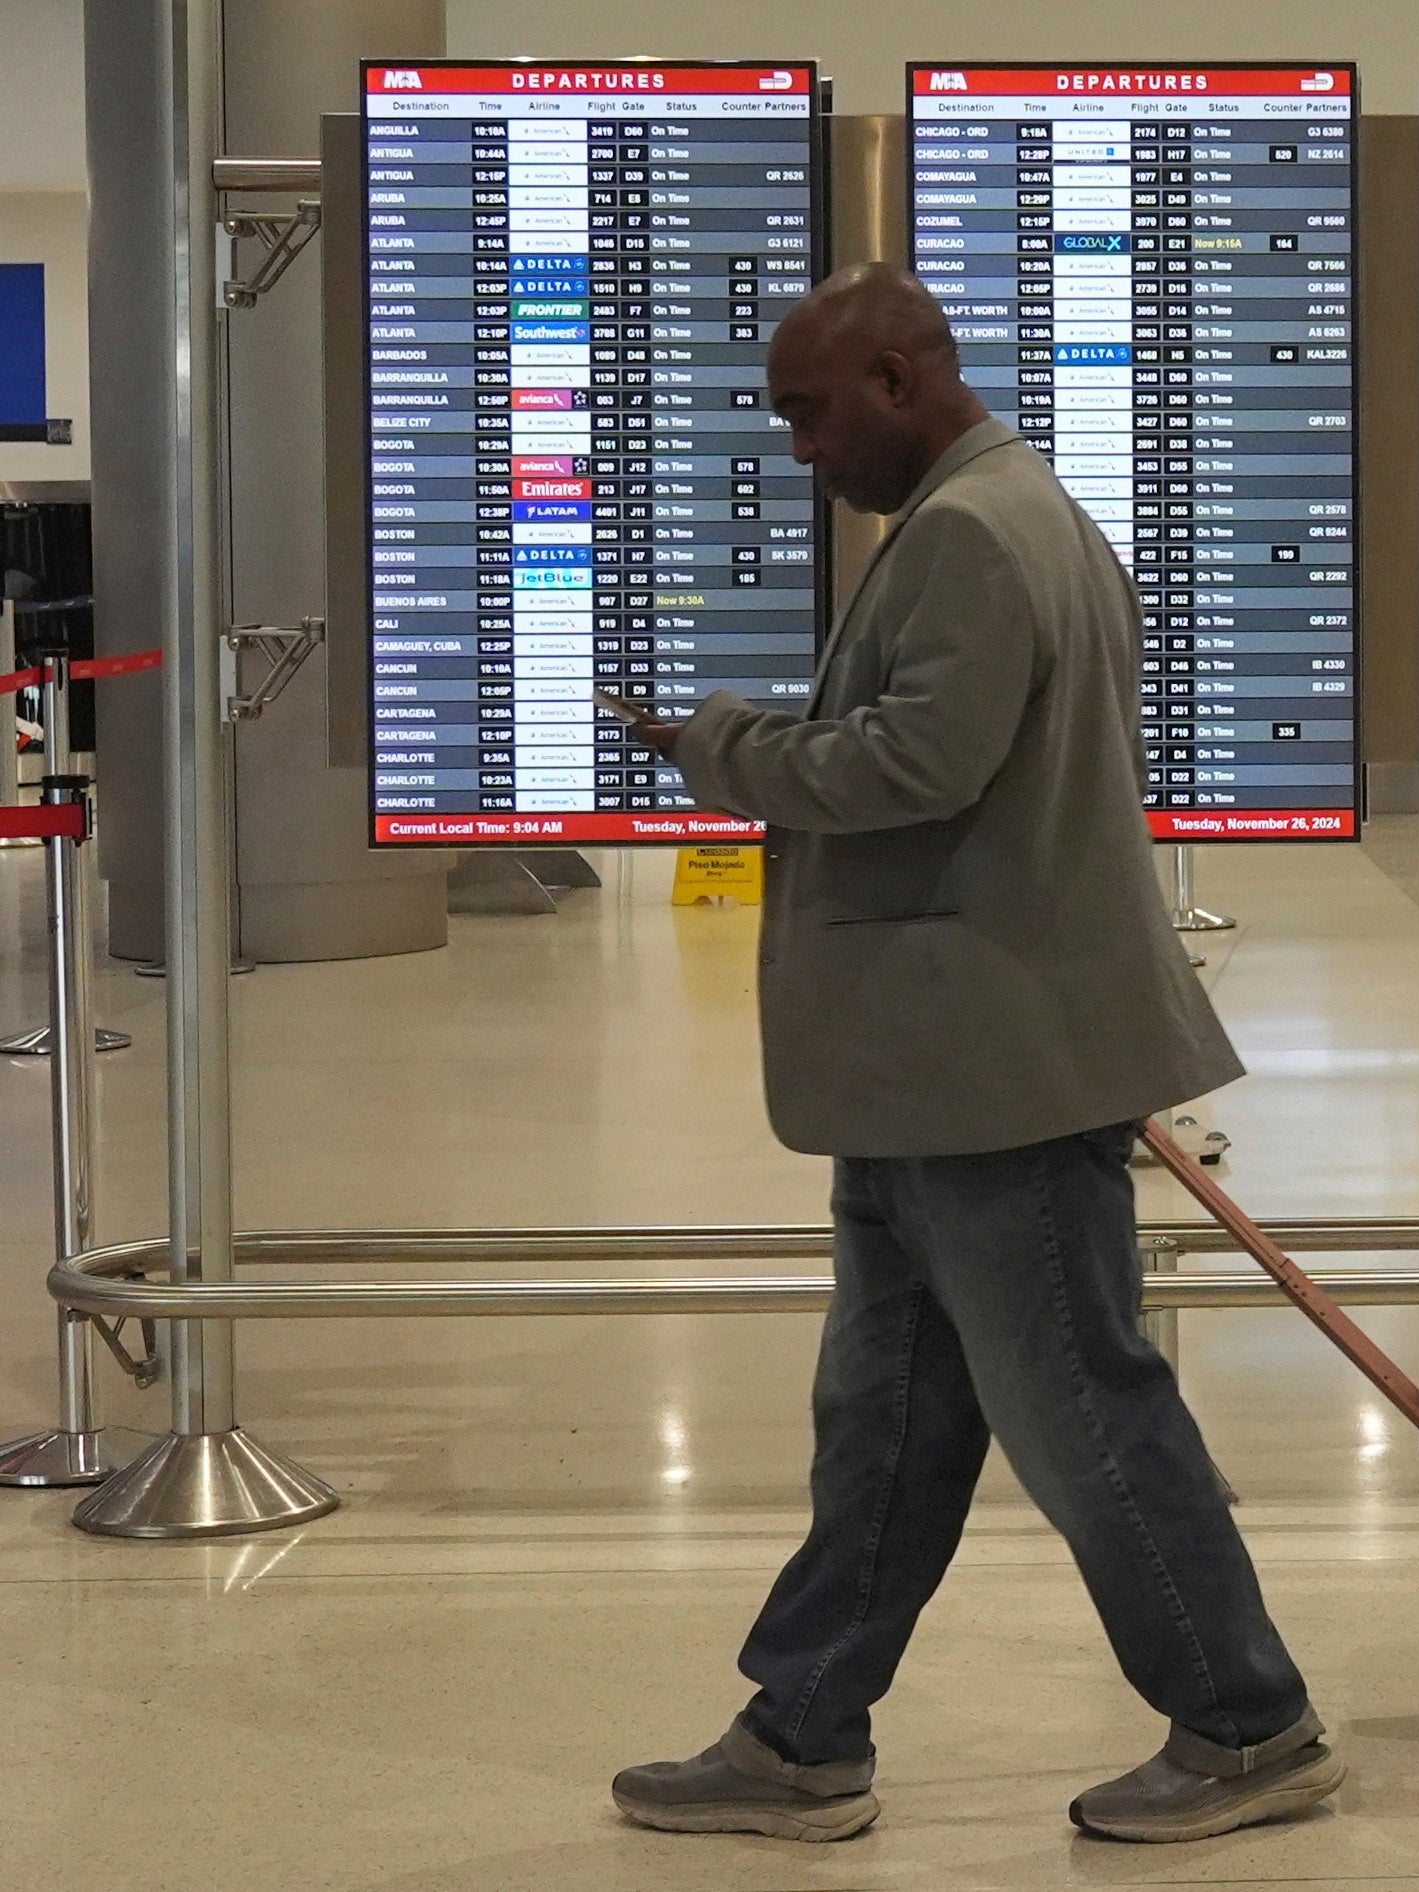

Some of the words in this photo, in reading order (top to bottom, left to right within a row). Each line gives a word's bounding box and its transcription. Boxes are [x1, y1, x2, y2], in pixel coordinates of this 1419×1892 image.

[513, 74, 665, 89] DEPARTURES
[1057, 75, 1207, 90] DEPARTURES
[393, 102, 450, 111] Destination
[479, 102, 502, 111] Time
[529, 102, 560, 111] Airline
[588, 102, 616, 113] Flight
[622, 102, 645, 111] Gate
[666, 102, 697, 111] Status
[722, 102, 761, 111] Counter
[765, 102, 806, 111] Partners
[938, 103, 994, 113] Destination
[1024, 103, 1047, 113] Time
[1073, 103, 1104, 113] Airline
[1131, 103, 1159, 114] Flight
[1165, 103, 1188, 113] Gate
[1208, 103, 1239, 113] Status
[1264, 103, 1302, 113] Counter
[1306, 103, 1347, 113] Partners
[370, 126, 419, 136] ANGUILLA
[1194, 128, 1209, 137] On
[1211, 128, 1231, 137] Time
[371, 149, 413, 159] ANTIGUA
[917, 217, 962, 226] COZUMEL
[371, 239, 414, 248] ATLANTA
[528, 260, 571, 269] DELTA
[518, 305, 582, 316] FRONTIER
[972, 306, 1008, 316] WORTH
[515, 327, 577, 339] Southwest
[373, 351, 427, 360] BARBADOS
[1072, 349, 1115, 359] DELTA
[373, 373, 448, 383] BARRANQUILLA
[519, 395, 555, 404] avianca
[374, 418, 405, 428] BELIZE
[407, 418, 431, 428] CITY
[374, 440, 414, 450] BOGOTA
[522, 482, 582, 496] Emirates
[538, 507, 578, 515] LATAM
[375, 530, 414, 540] BOSTON
[531, 551, 574, 560] DELTA
[521, 573, 584, 585] jetBlue
[375, 596, 413, 606] BUENOS
[416, 596, 446, 606] AIRES
[657, 596, 676, 605] Now
[376, 619, 398, 628] CALI
[1310, 616, 1324, 626] QR
[1326, 616, 1347, 626] 2372
[376, 641, 432, 652] CAMAGUEY,
[435, 641, 461, 651] CUBA
[377, 664, 417, 673] CANCUN
[377, 708, 436, 718] CARTAGENA
[1279, 728, 1295, 737] 335
[377, 753, 435, 762] CHARLOTTE
[391, 822, 436, 835] Current
[439, 822, 470, 835] Local
[473, 822, 510, 835] Time:
[513, 822, 539, 835] 9:04
[541, 822, 562, 835] AM
[633, 821, 685, 836] Tuesday,
[689, 820, 750, 833] November
[1173, 818, 1225, 831] Tuesday,
[1228, 818, 1288, 829] November
[1292, 818, 1310, 831] 26,
[1312, 818, 1341, 829] 2024
